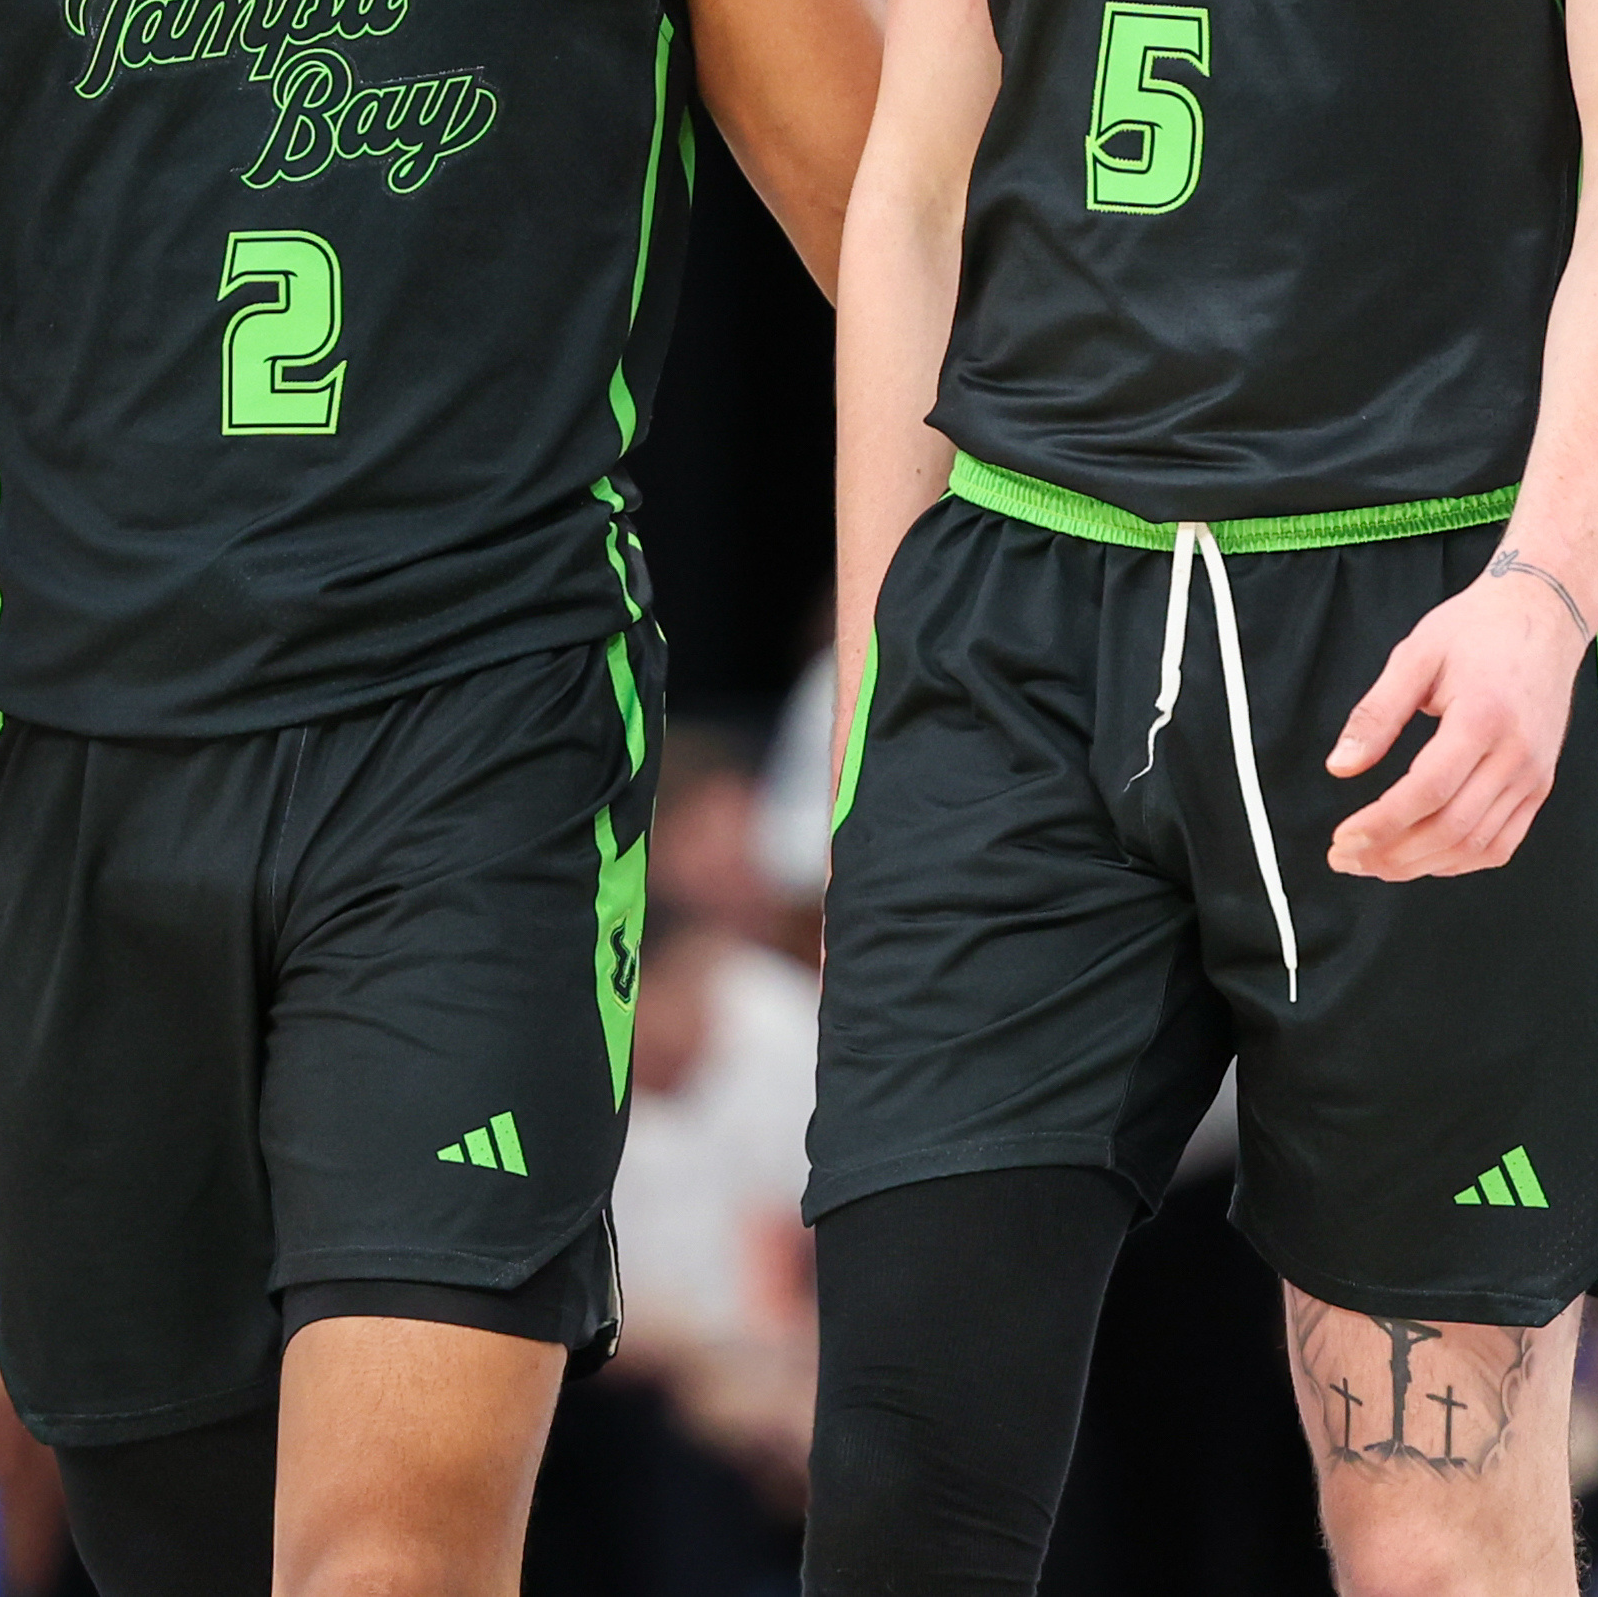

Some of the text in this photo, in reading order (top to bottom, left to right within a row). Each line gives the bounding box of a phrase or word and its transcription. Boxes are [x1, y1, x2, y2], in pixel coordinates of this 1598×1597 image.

[240, 47, 498, 195] Bay
[1085, 0, 1210, 215] 5
[217, 229, 348, 436] 2
